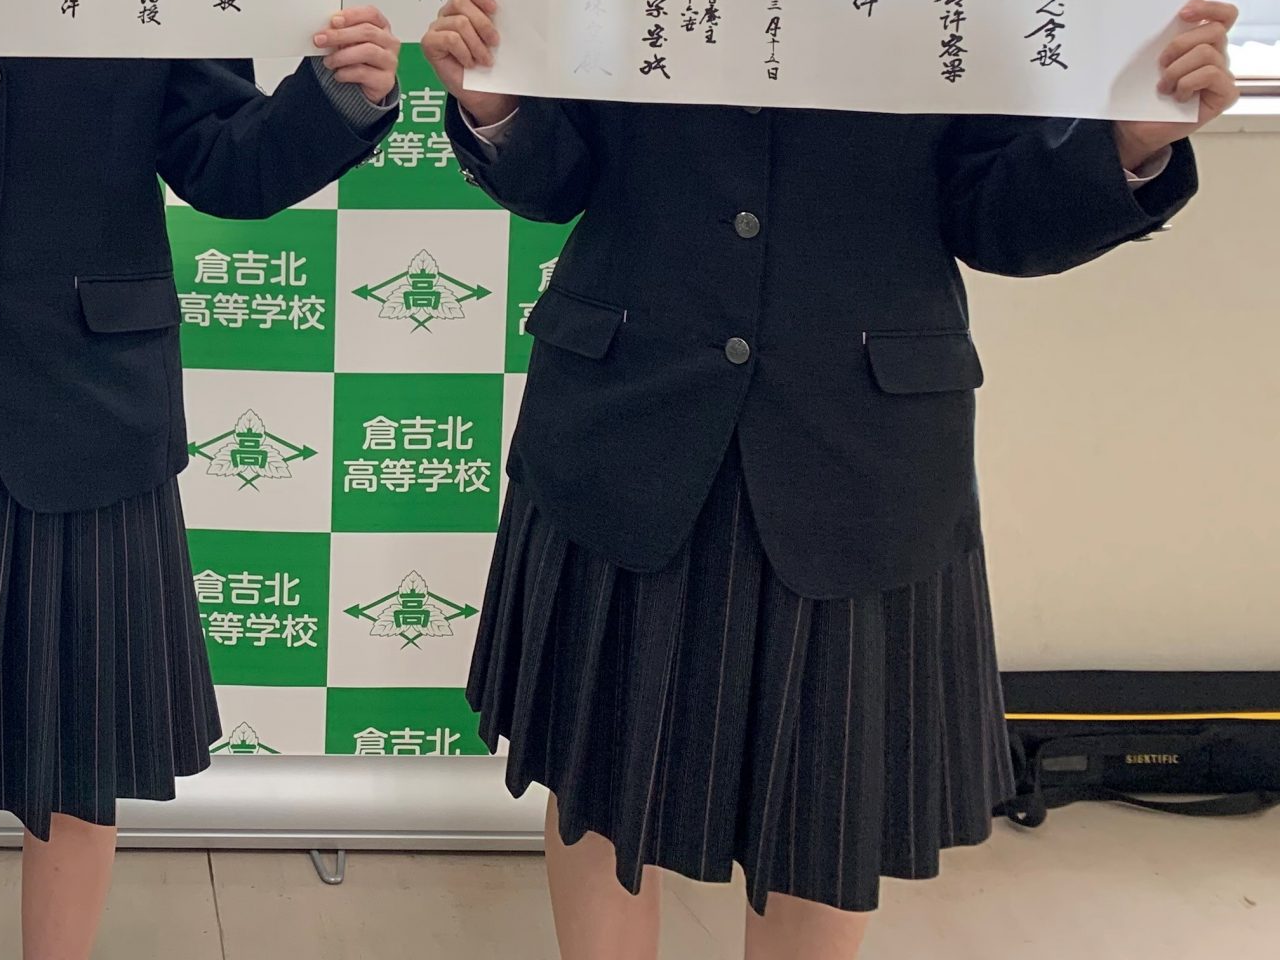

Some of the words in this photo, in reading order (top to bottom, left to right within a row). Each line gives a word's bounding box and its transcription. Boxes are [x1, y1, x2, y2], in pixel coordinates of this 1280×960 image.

[397, 86, 446, 123] 吉
[365, 130, 457, 168] 等学
[194, 247, 308, 288] 倉吉北
[178, 290, 326, 331] 高等学校
[362, 415, 474, 451] 倉吉北
[343, 457, 491, 494] 高等学校
[192, 568, 301, 607] 倉吉北
[199, 611, 318, 648] 等学校
[351, 726, 461, 755] 倉吉北
